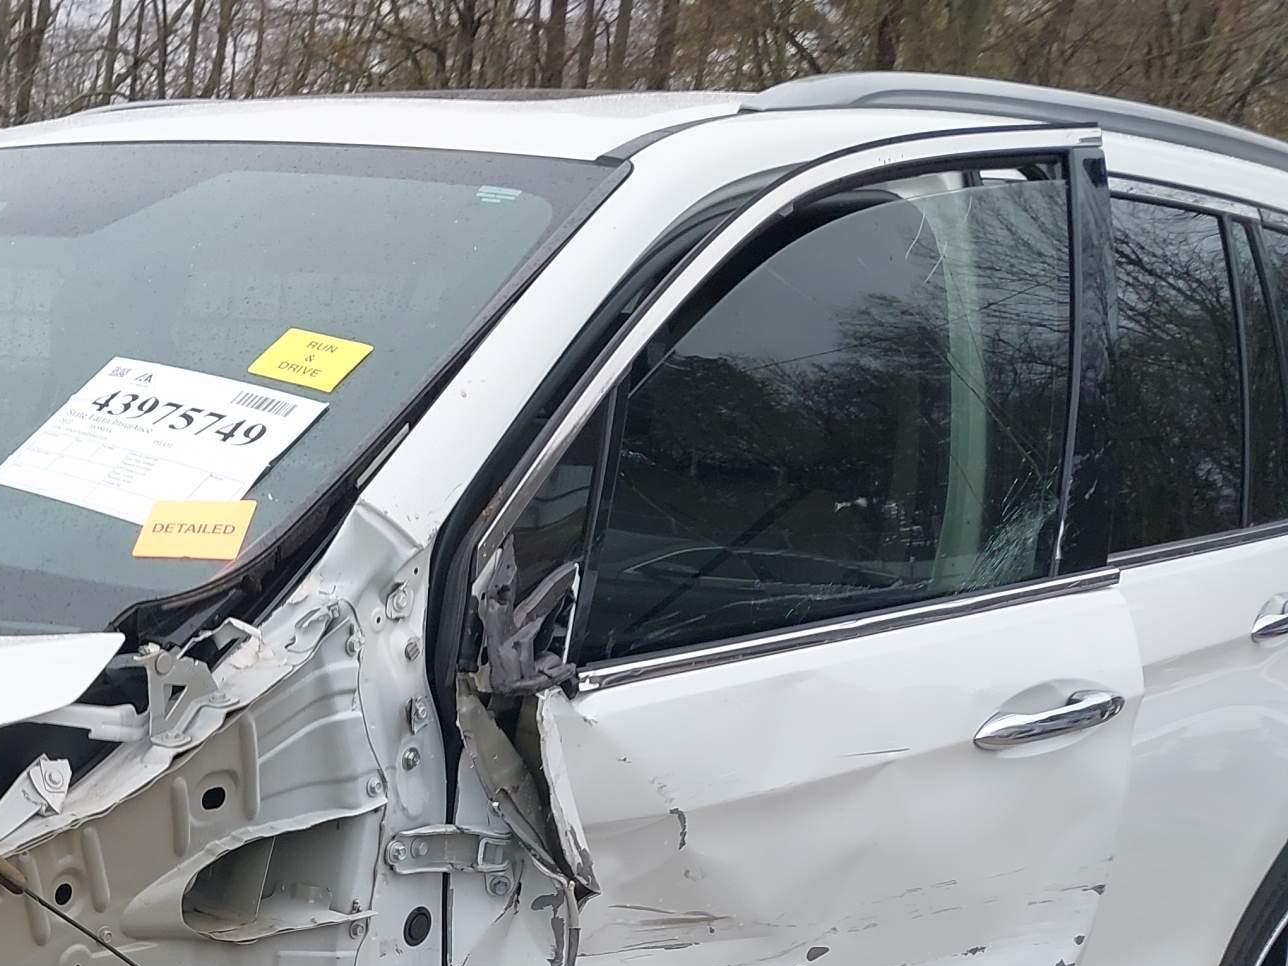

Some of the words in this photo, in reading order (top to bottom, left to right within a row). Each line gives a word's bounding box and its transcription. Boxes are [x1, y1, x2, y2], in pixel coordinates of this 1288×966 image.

[306, 340, 339, 353] RUN
[304, 354, 315, 362] &
[277, 360, 321, 378] DRIVE
[92, 389, 267, 446] 43975749
[151, 522, 236, 535] DETAILED
